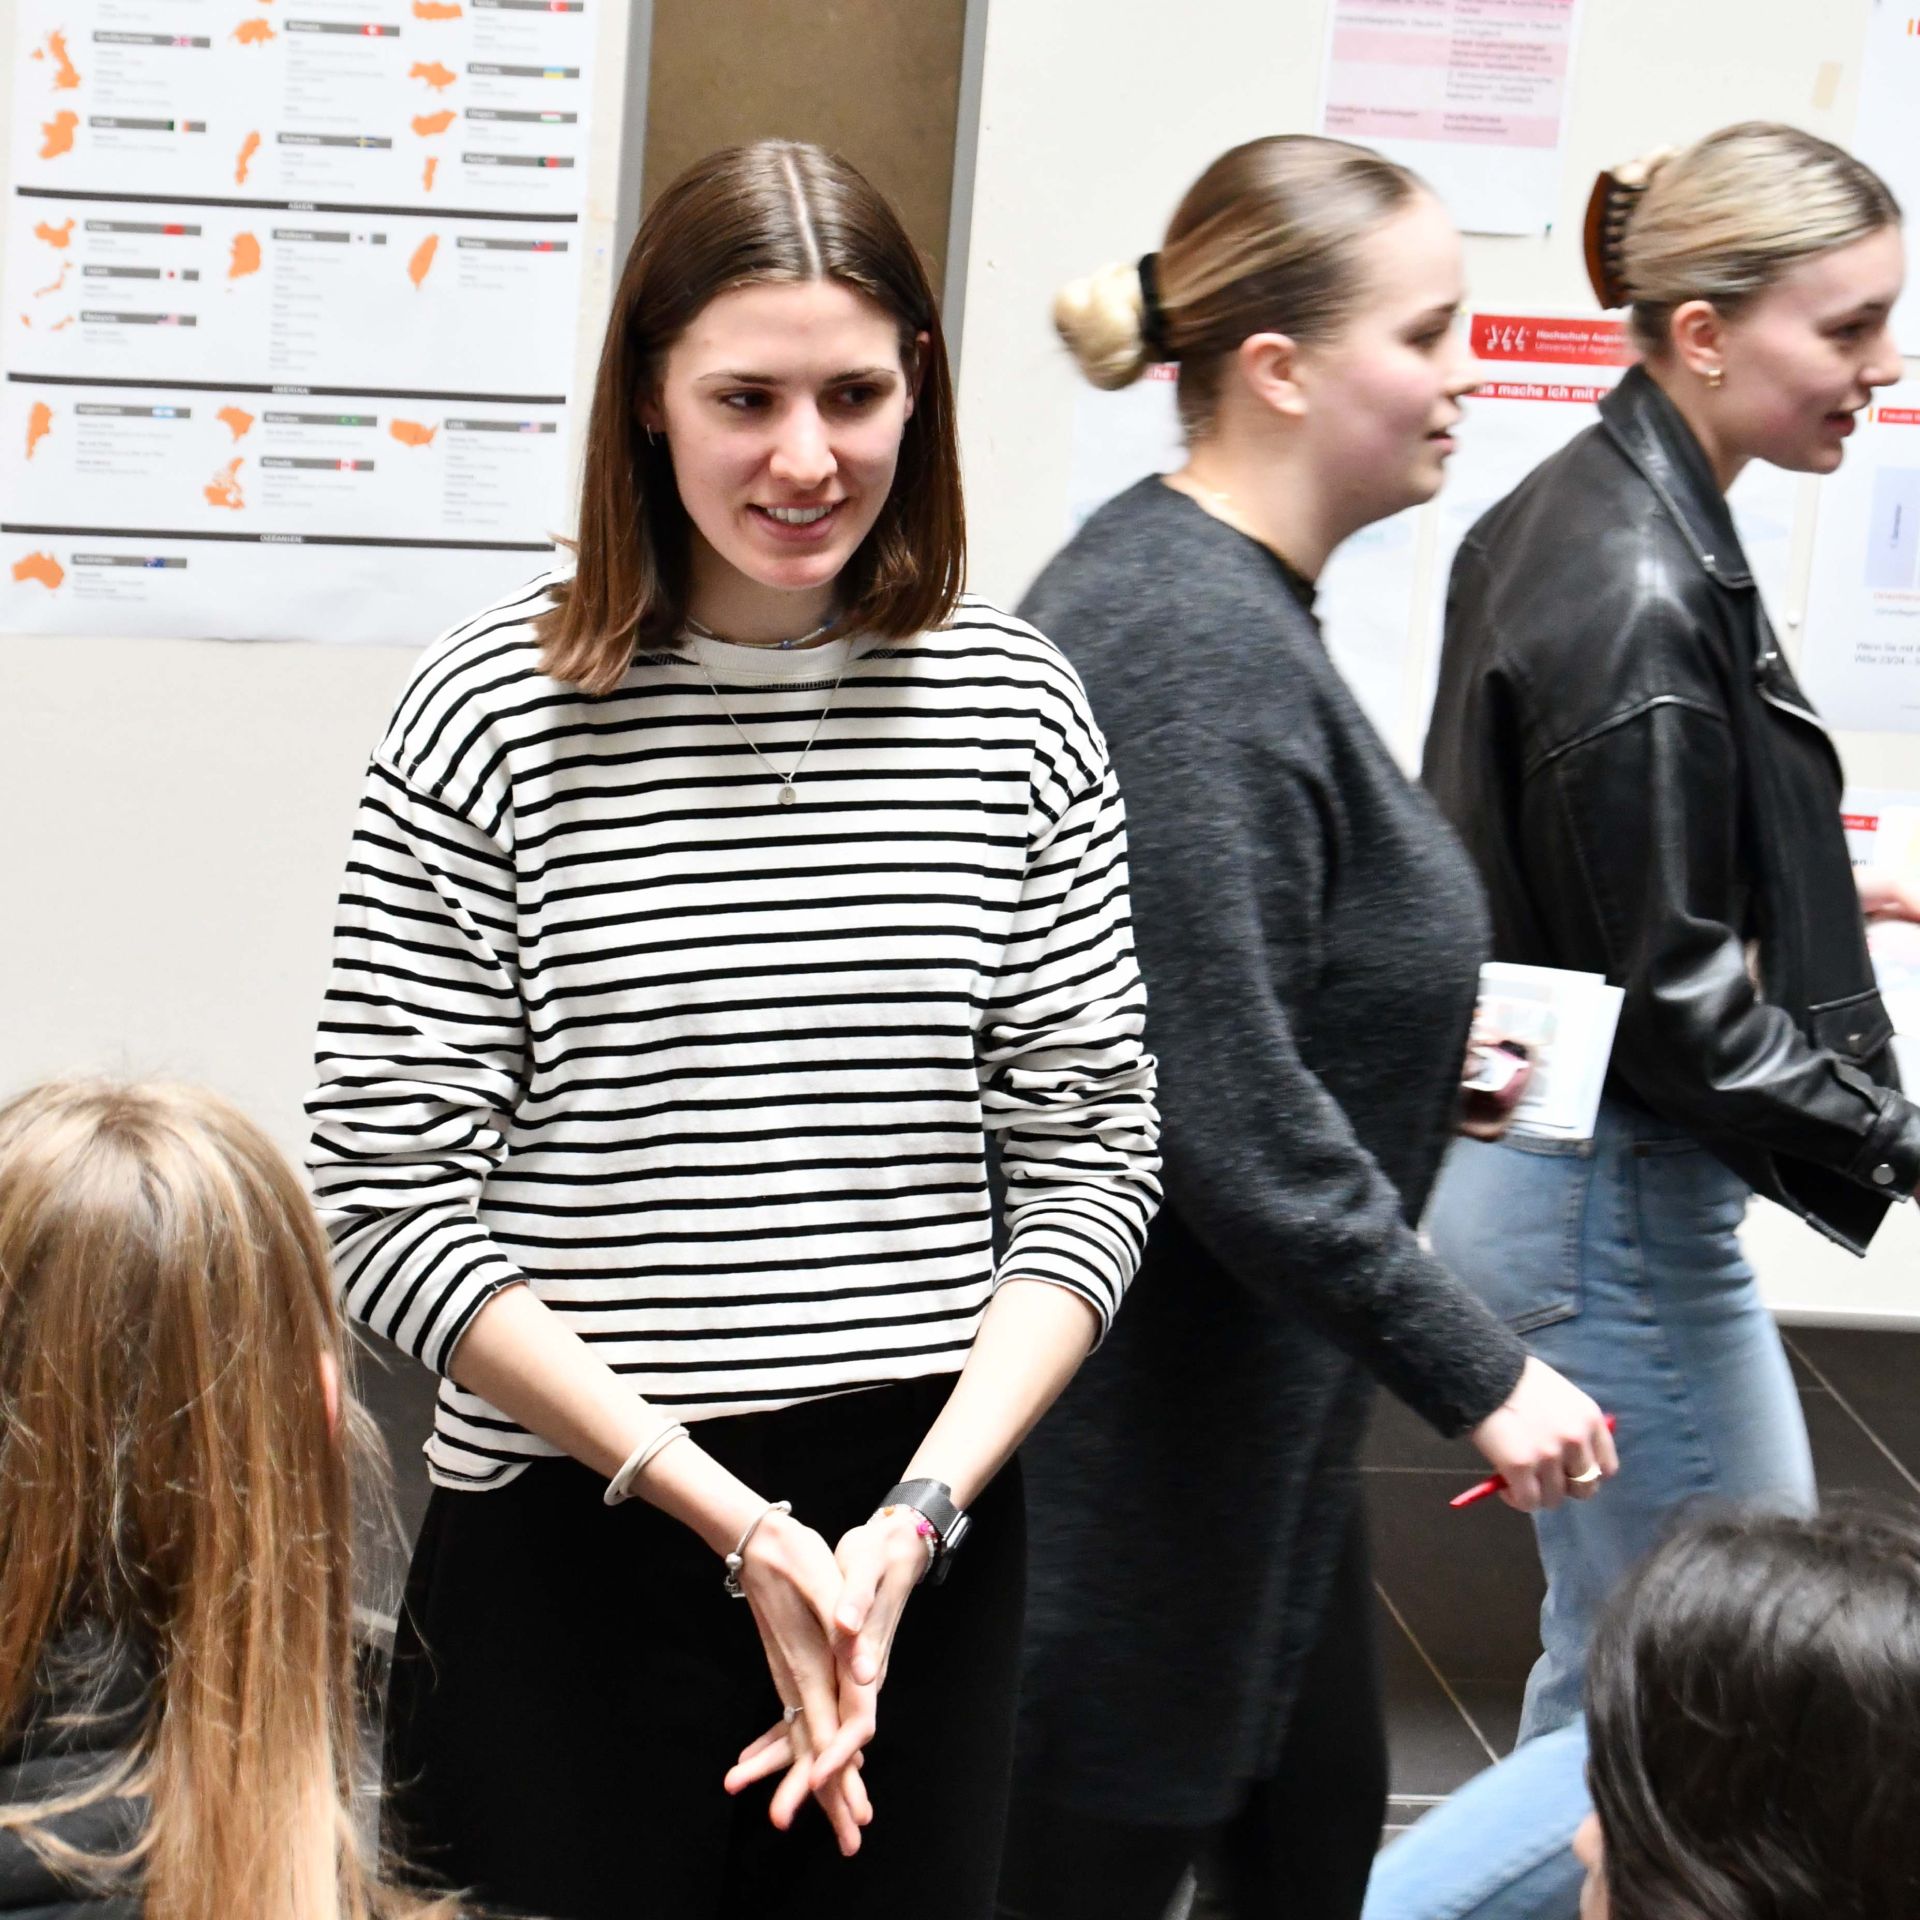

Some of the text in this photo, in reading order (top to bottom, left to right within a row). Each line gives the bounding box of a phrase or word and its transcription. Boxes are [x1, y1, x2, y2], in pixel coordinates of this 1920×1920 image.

[1536, 329, 1589, 341] Hochschule
[1535, 342, 1576, 353] University
[272, 384, 309, 395] AMERIKA
[1498, 384, 1545, 397] mache
[1547, 385, 1569, 398] ich
[1572, 386, 1594, 399] mit
